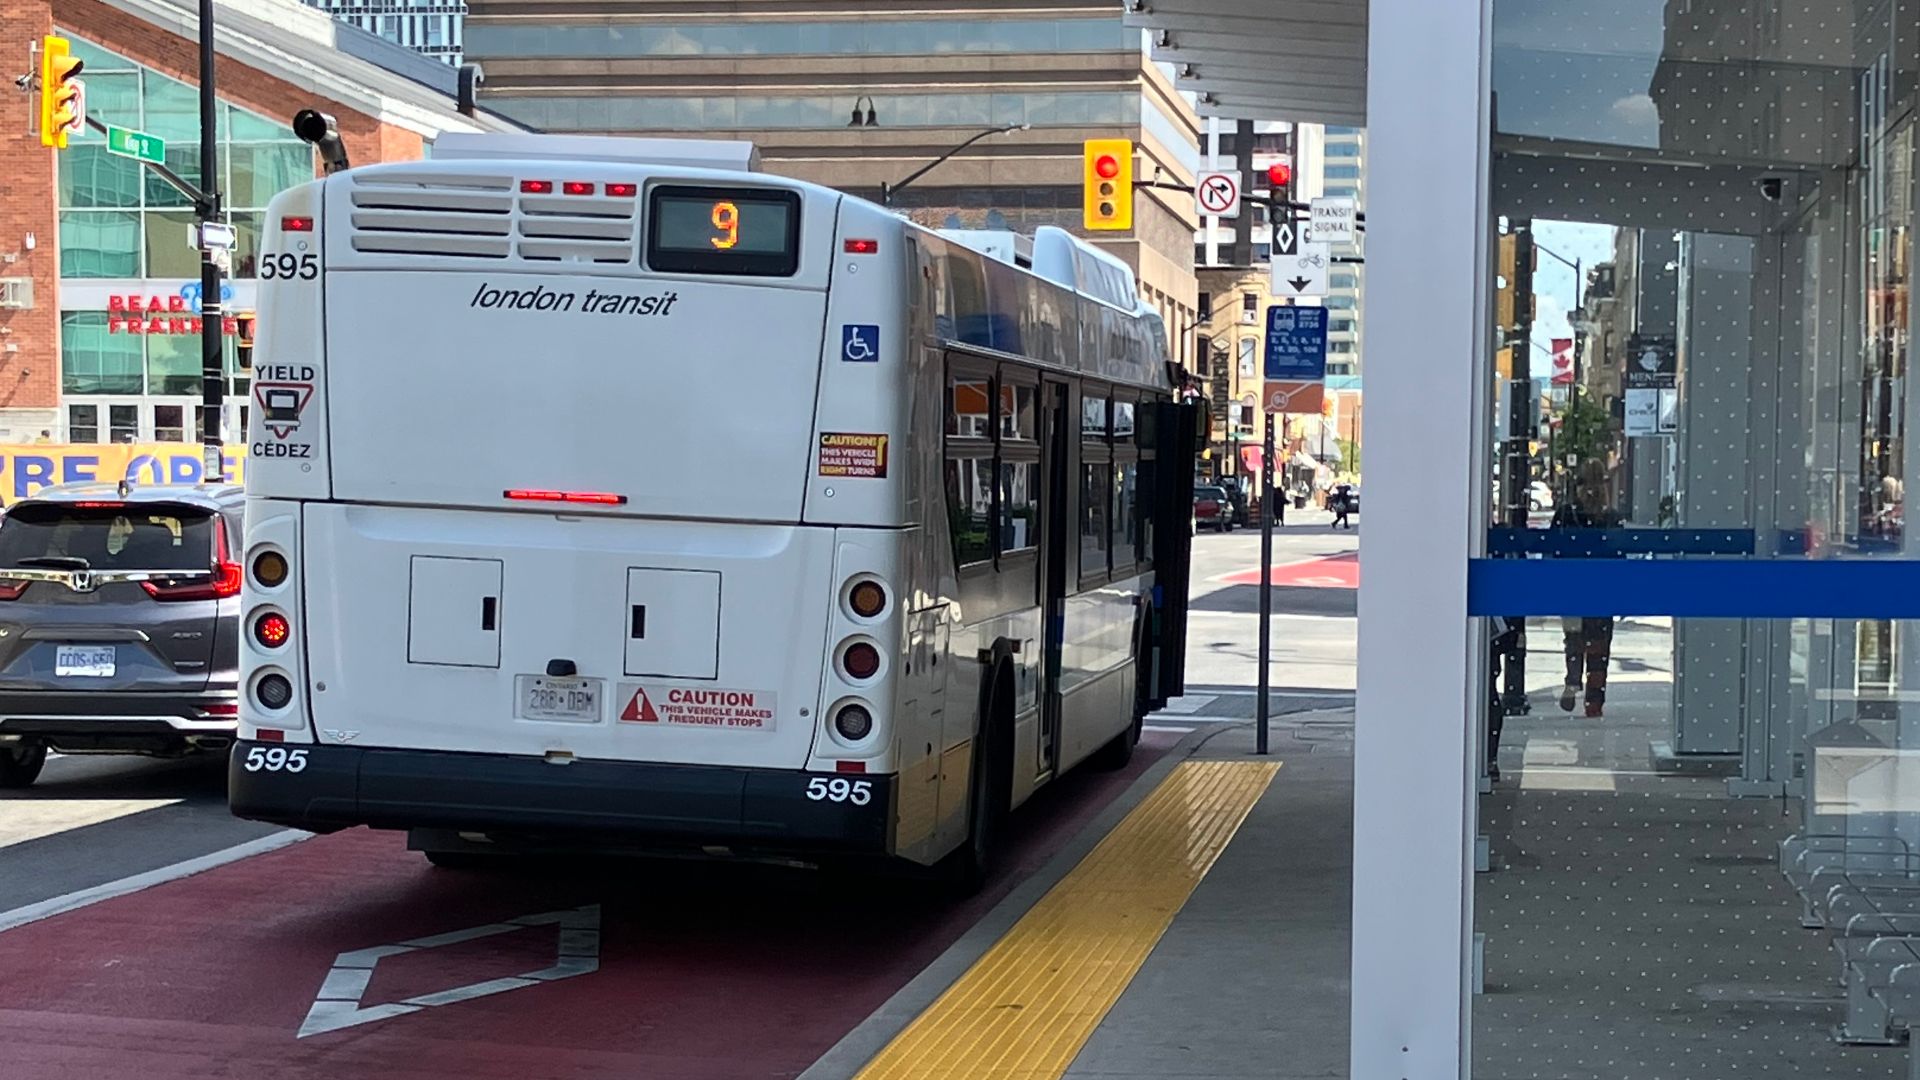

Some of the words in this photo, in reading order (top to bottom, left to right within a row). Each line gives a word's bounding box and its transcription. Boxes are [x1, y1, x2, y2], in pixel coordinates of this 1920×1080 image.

[1312, 207, 1352, 217] TRANSIT
[711, 202, 738, 248] 9
[1314, 222, 1349, 232] SIGNAL
[261, 253, 318, 280] 595
[471, 282, 575, 311] london
[581, 289, 678, 315] transit
[255, 365, 314, 381] YIELD
[253, 440, 311, 458] CÉDEZ
[821, 448, 840, 456] THIS
[841, 449, 876, 457] VEHICLE
[821, 457, 851, 465] MAKES
[852, 459, 876, 467] WIDE
[847, 467, 876, 475] TURNS
[669, 689, 753, 706] CAUTION
[659, 704, 683, 714] THIS
[687, 706, 731, 716] VEHICLE
[735, 709, 772, 718] MAKES
[668, 714, 724, 725] FREQUENT
[728, 717, 762, 727] STOPS
[244, 747, 309, 773] 595
[806, 777, 872, 805] 595
